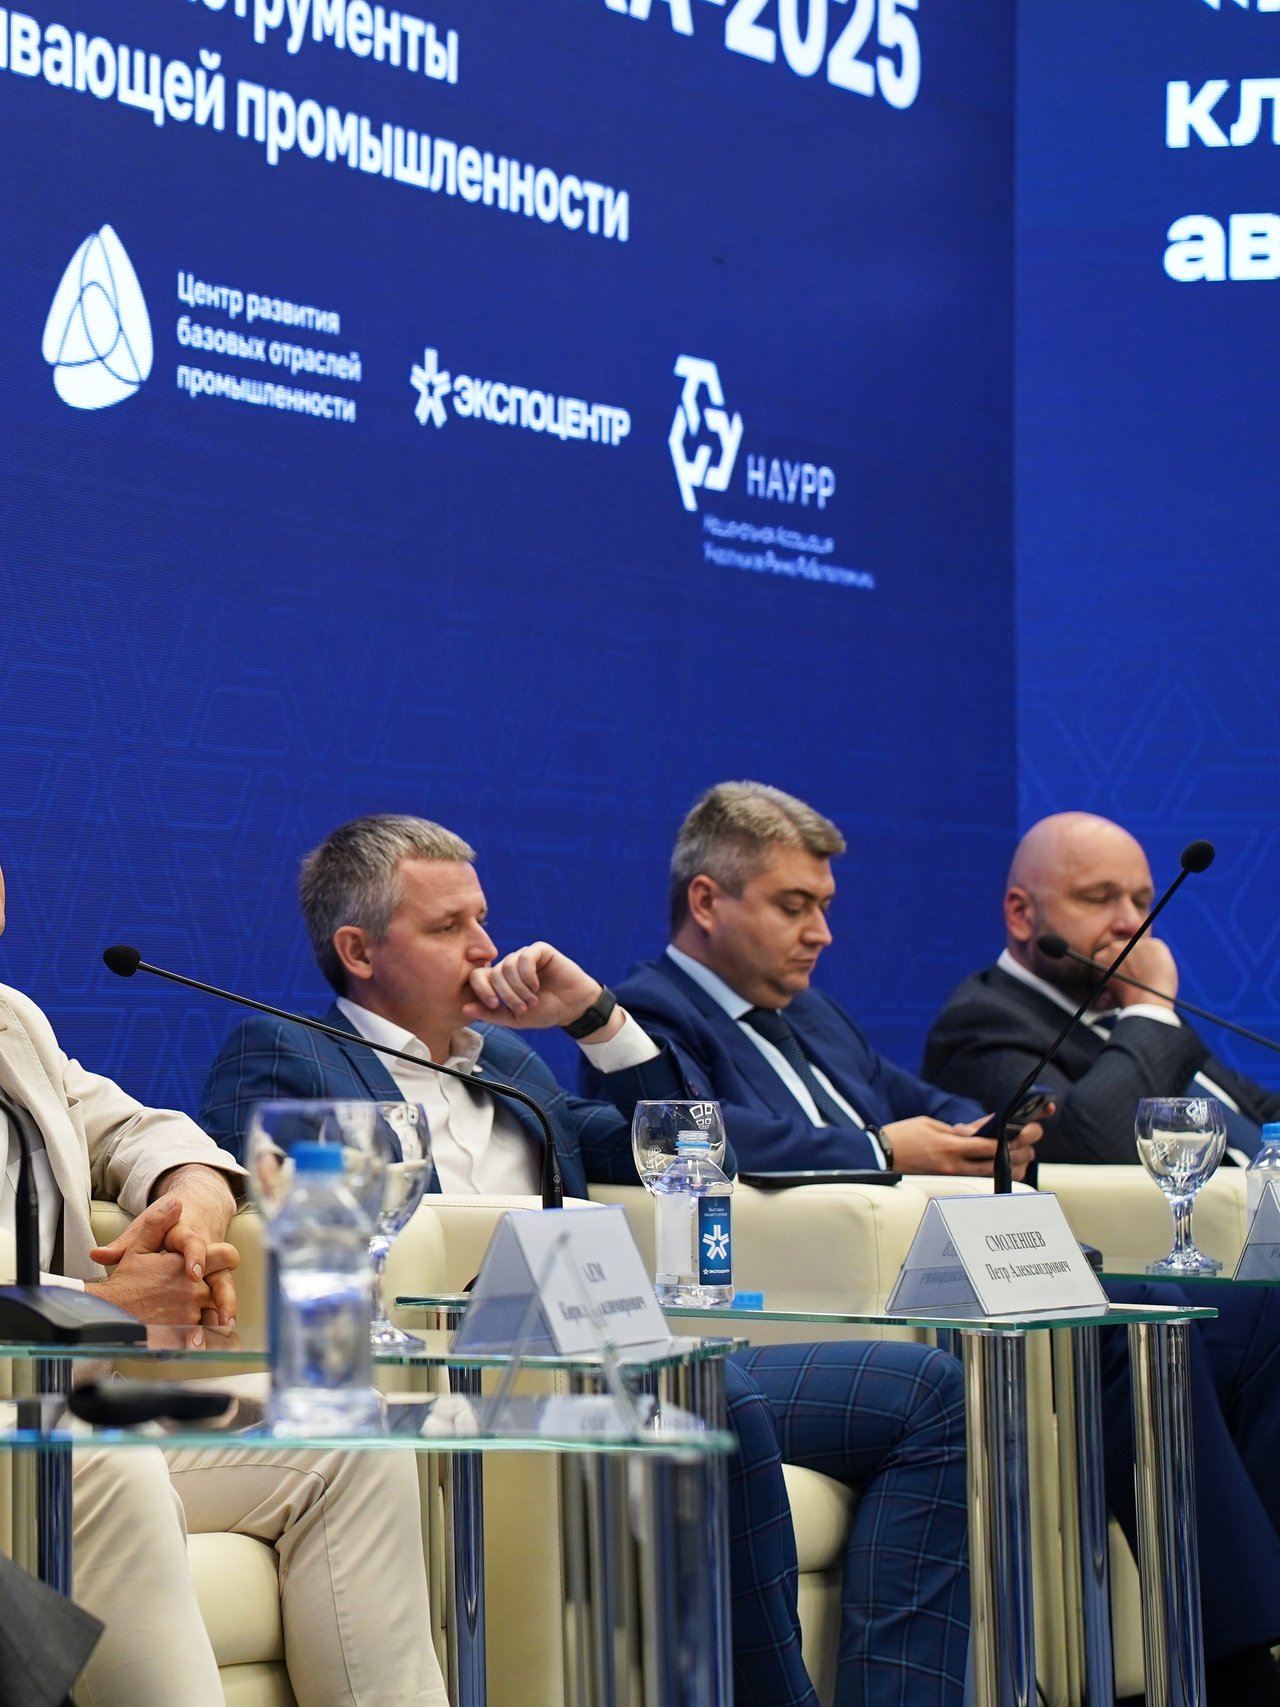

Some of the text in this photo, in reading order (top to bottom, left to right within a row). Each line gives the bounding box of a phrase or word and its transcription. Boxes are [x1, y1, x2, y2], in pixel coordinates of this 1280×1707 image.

[236, 79, 630, 243] промышленности
[177, 270, 340, 335] Центр развития
[177, 316, 362, 382] базовых отраслей
[177, 365, 356, 423] промышленности
[453, 375, 631, 445] ЭКСПОЦЕНТР
[747, 453, 836, 511] НАУРР
[985, 1231, 1046, 1252] СМОЛЕНЦЕВ
[985, 1263, 1011, 1283] Петр
[1008, 1261, 1071, 1279] Александрович
